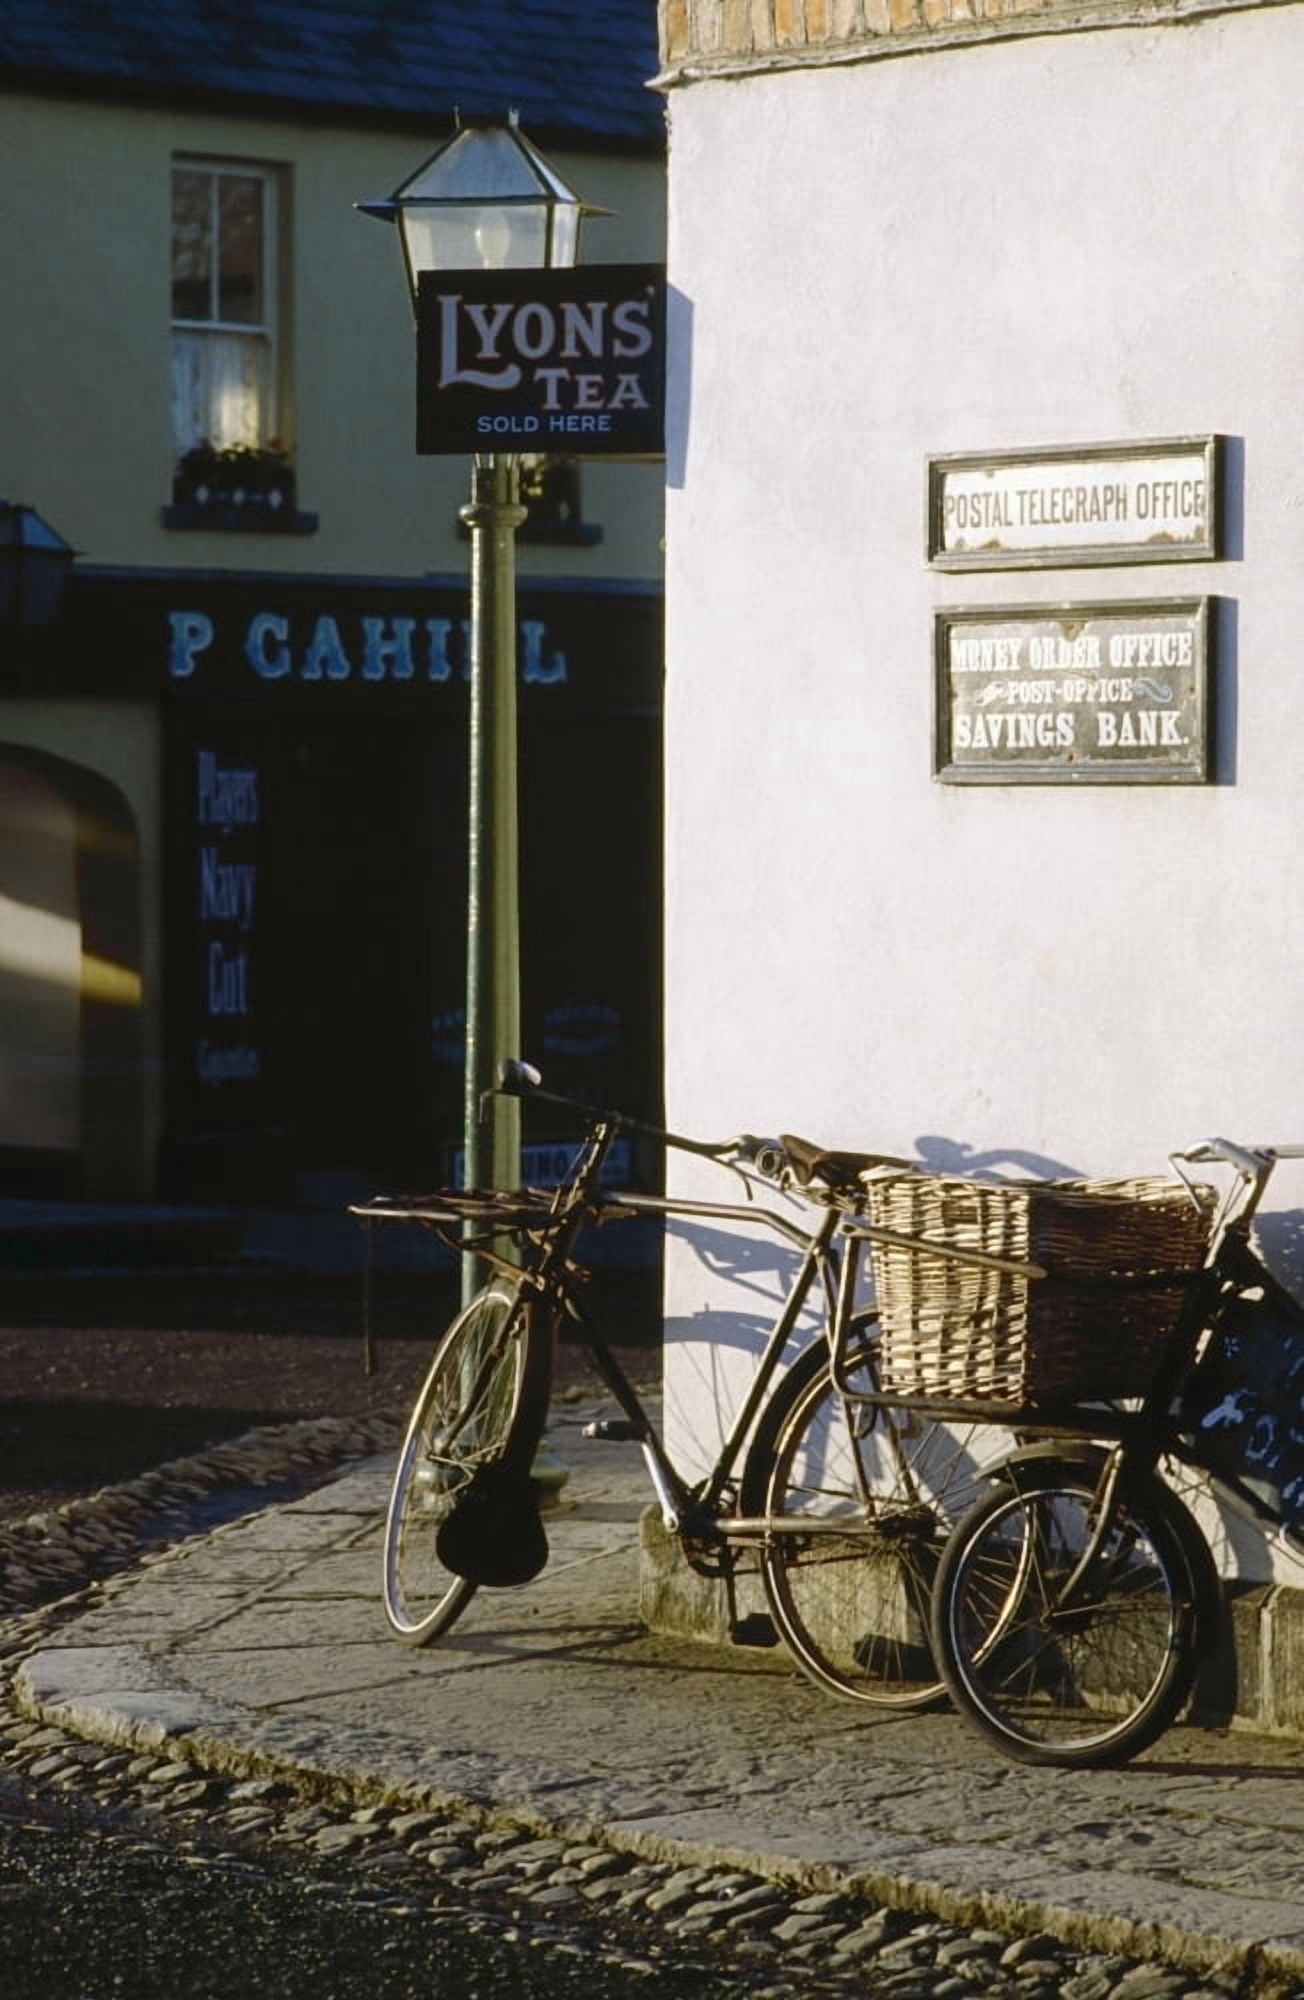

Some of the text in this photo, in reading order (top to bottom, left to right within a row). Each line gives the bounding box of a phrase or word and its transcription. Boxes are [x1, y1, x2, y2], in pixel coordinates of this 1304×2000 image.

[533, 367, 650, 411] TEA
[477, 414, 612, 433] SOLD HERE
[944, 479, 1204, 529] POSTAL TELEGRAPH OFFICE
[165, 609, 569, 685] P CAHIL
[953, 631, 1193, 672] MONEY ORDER OFFICE
[1007, 677, 1134, 705] POST-OFFICE
[954, 710, 1190, 748] SAVINGS BANK.
[199, 846, 257, 931] Navy
[208, 940, 249, 1016] Cut
